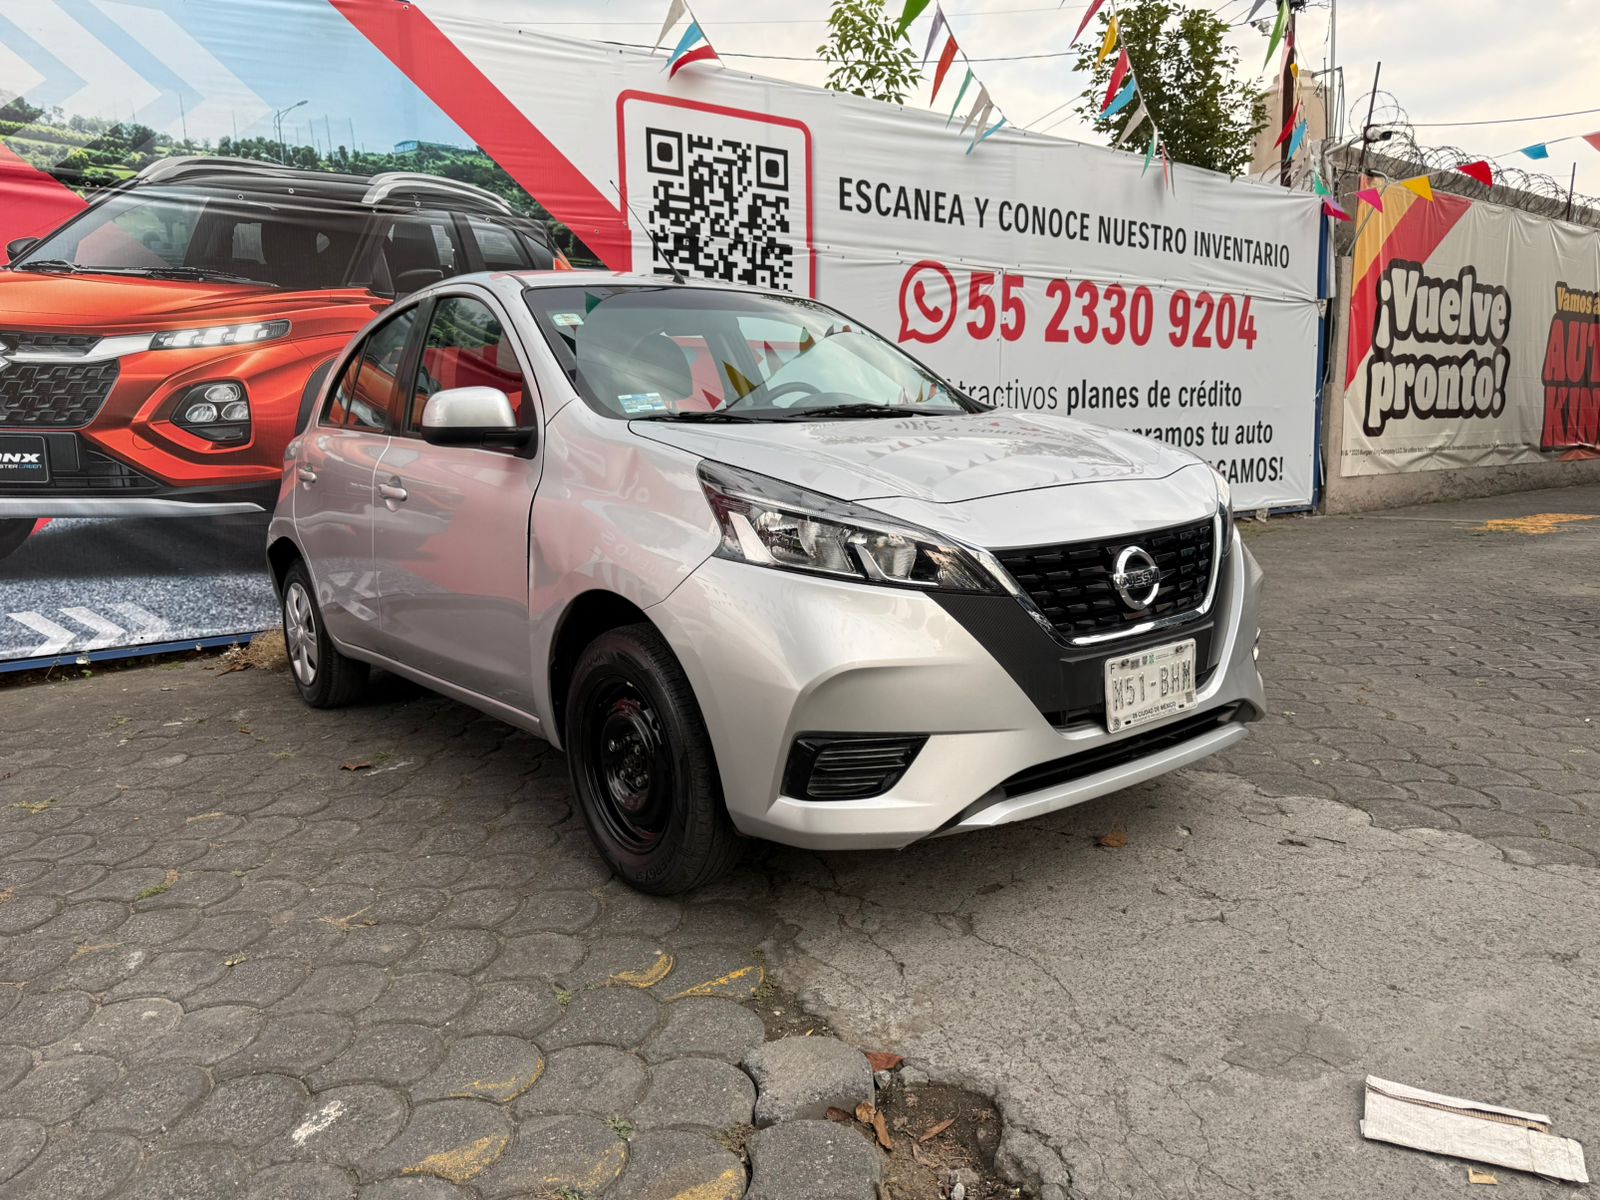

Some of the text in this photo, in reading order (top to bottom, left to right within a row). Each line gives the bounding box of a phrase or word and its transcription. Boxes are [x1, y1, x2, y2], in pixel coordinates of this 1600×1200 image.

[838, 176, 1291, 269] ESCANEA Y CONOCE NUESTRO INVENTARIO
[966, 271, 1258, 350] 55 2330 9204
[1374, 261, 1510, 350] ¡Vuelve
[1556, 284, 1593, 314] Vamos
[1066, 378, 1140, 416] planes
[1147, 379, 1171, 409] de
[1177, 379, 1243, 408] crédito
[1365, 351, 1509, 435] pronto!
[1211, 421, 1229, 446] tu
[1235, 420, 1273, 444] auto
[0, 453, 41, 463] NX
[1209, 456, 1284, 485] GAMOS!
